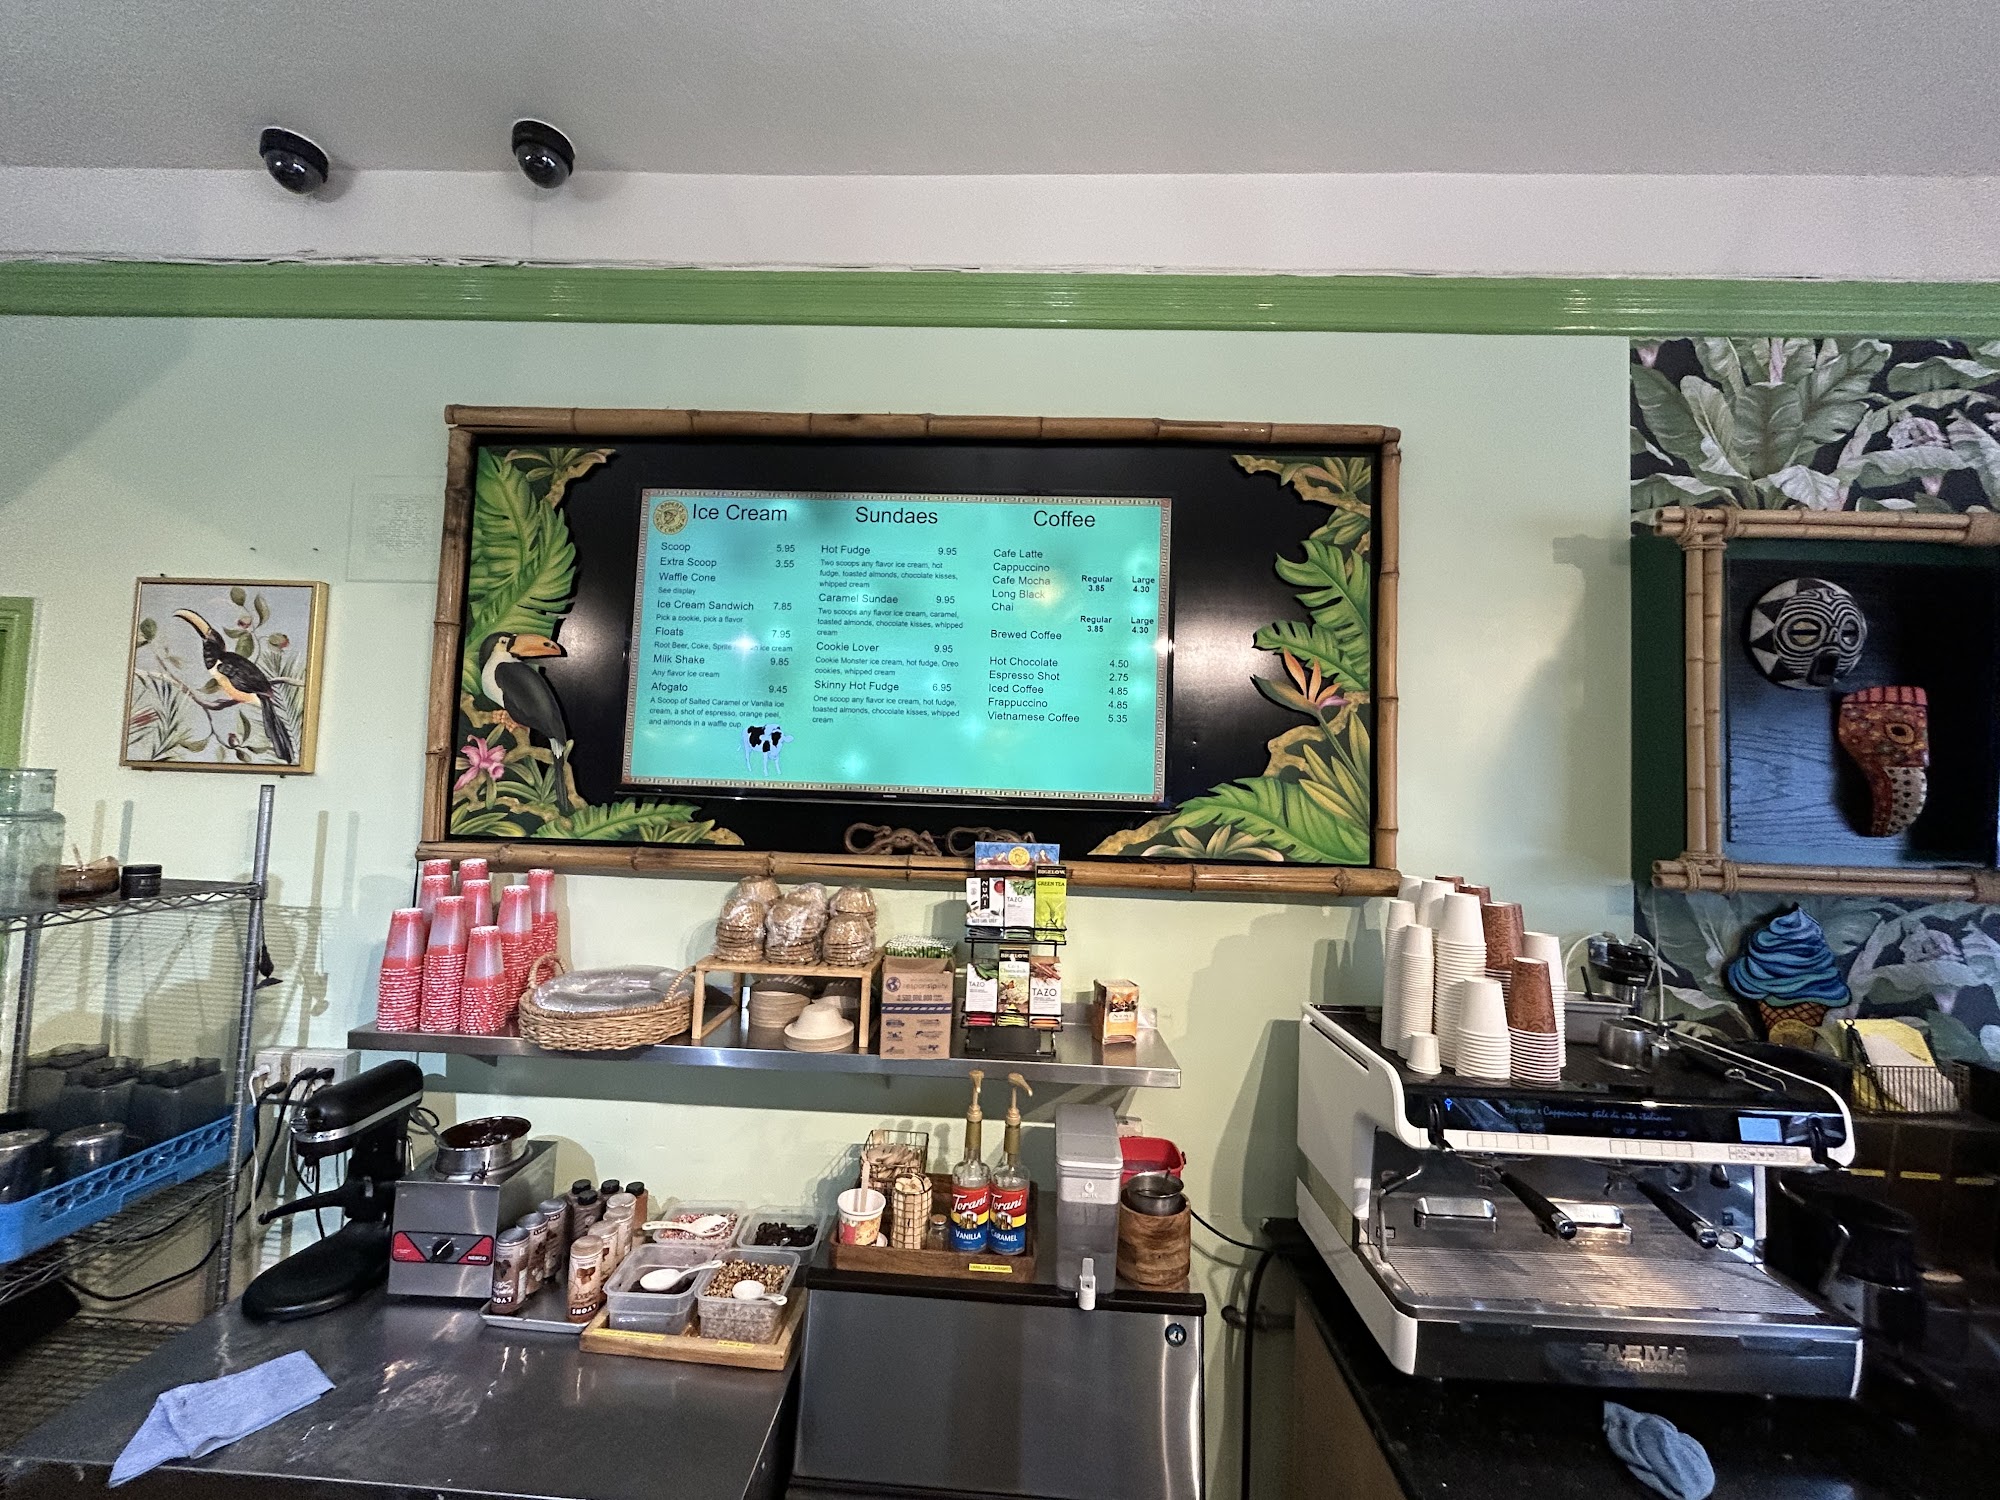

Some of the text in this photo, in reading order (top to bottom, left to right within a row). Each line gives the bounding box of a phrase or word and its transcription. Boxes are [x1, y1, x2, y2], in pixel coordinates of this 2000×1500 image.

[693, 504, 787, 521] Ice Cream
[856, 506, 938, 524] Sundaes
[1034, 511, 1096, 528] Coffee
[661, 542, 795, 553] Scoop 5.95
[821, 545, 957, 556] Hot Fudge 9.95
[994, 549, 1043, 558] Cafe Latte
[660, 558, 794, 569] Extra Scoop 3.55
[993, 563, 1050, 573] Cappuccino
[659, 573, 716, 582] Waffle Cone
[819, 570, 839, 578] fudge,
[869, 571, 898, 579] almonds,
[935, 572, 958, 580] kisses,
[1082, 575, 1155, 585] Regular Large
[993, 576, 1051, 586] Cafe Mocha
[1133, 585, 1150, 593] 4.30
[819, 594, 955, 604] Caramel Sundae 9.95
[992, 590, 1045, 600] Long Black
[657, 600, 792, 610] Ice Cream Sandwich 7.85
[992, 603, 1014, 612] Chai
[678, 615, 701, 623] cookie,
[1080, 616, 1154, 626] Regular Large
[656, 627, 790, 638] Floats 7.95
[991, 630, 1062, 640] Brewed Coffee
[654, 641, 670, 649] Root
[672, 642, 689, 650] Beer,
[817, 642, 953, 653] Cookie Lover 9.95
[654, 655, 789, 666] Milk Shake 9.85
[841, 657, 868, 665] Monster
[919, 660, 939, 668] fudge,
[990, 657, 1128, 668] Hot Chocolate 4.50
[652, 670, 665, 678] Any
[844, 668, 872, 676] whipped
[989, 670, 1128, 682] Espresso Shot 2.75
[651, 682, 787, 693] Afogato 9.45
[815, 680, 952, 692] Skinny Hot Fudge 6.95
[989, 684, 1009, 693] Iced
[1012, 685, 1044, 694] Coffee
[988, 698, 1128, 709] Frappuccino 4.85
[705, 710, 737, 718] espresso,
[740, 711, 763, 719] orange
[988, 711, 1128, 723] Vietnamese Coffee 5.35
[981, 881, 989, 905] NUMI
[1032, 988, 1057, 996] TAZO
[953, 1192, 987, 1212] Torani
[991, 1193, 1023, 1210] Torani
[955, 1230, 981, 1239] VANILLA
[991, 1229, 1017, 1241] CARAMEL
[572, 1304, 597, 1315] LYONS
